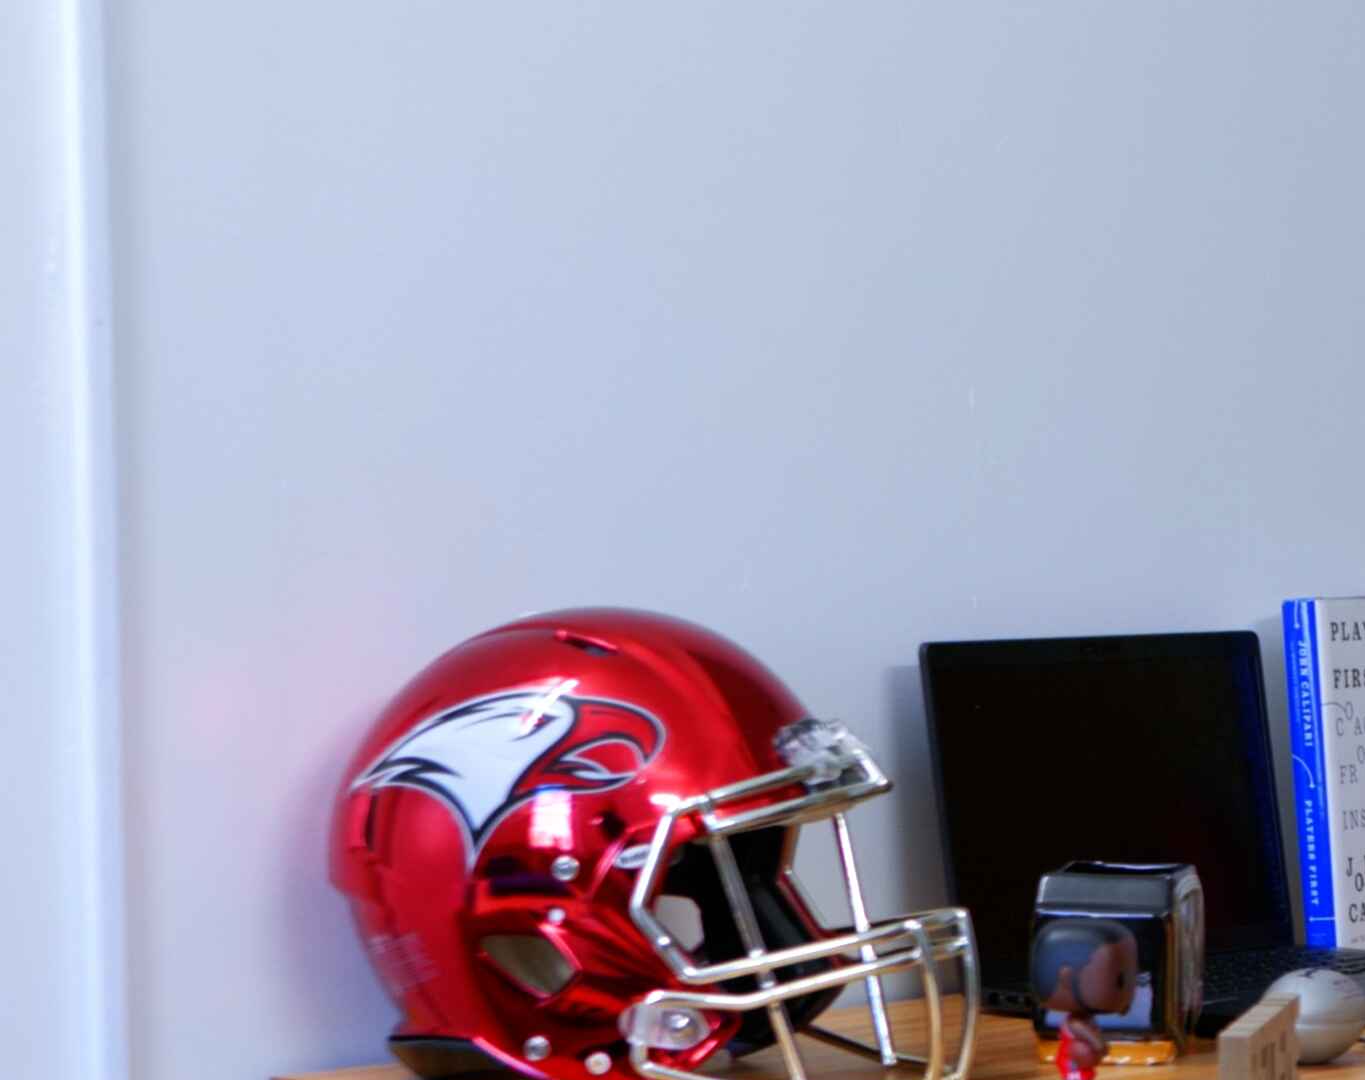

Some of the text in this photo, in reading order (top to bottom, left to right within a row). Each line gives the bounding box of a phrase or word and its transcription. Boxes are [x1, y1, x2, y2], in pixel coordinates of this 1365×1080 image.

[1297, 640, 1313, 748] JOHN CALIPARI
[1303, 799, 1319, 906] PLAYERS FIRST
